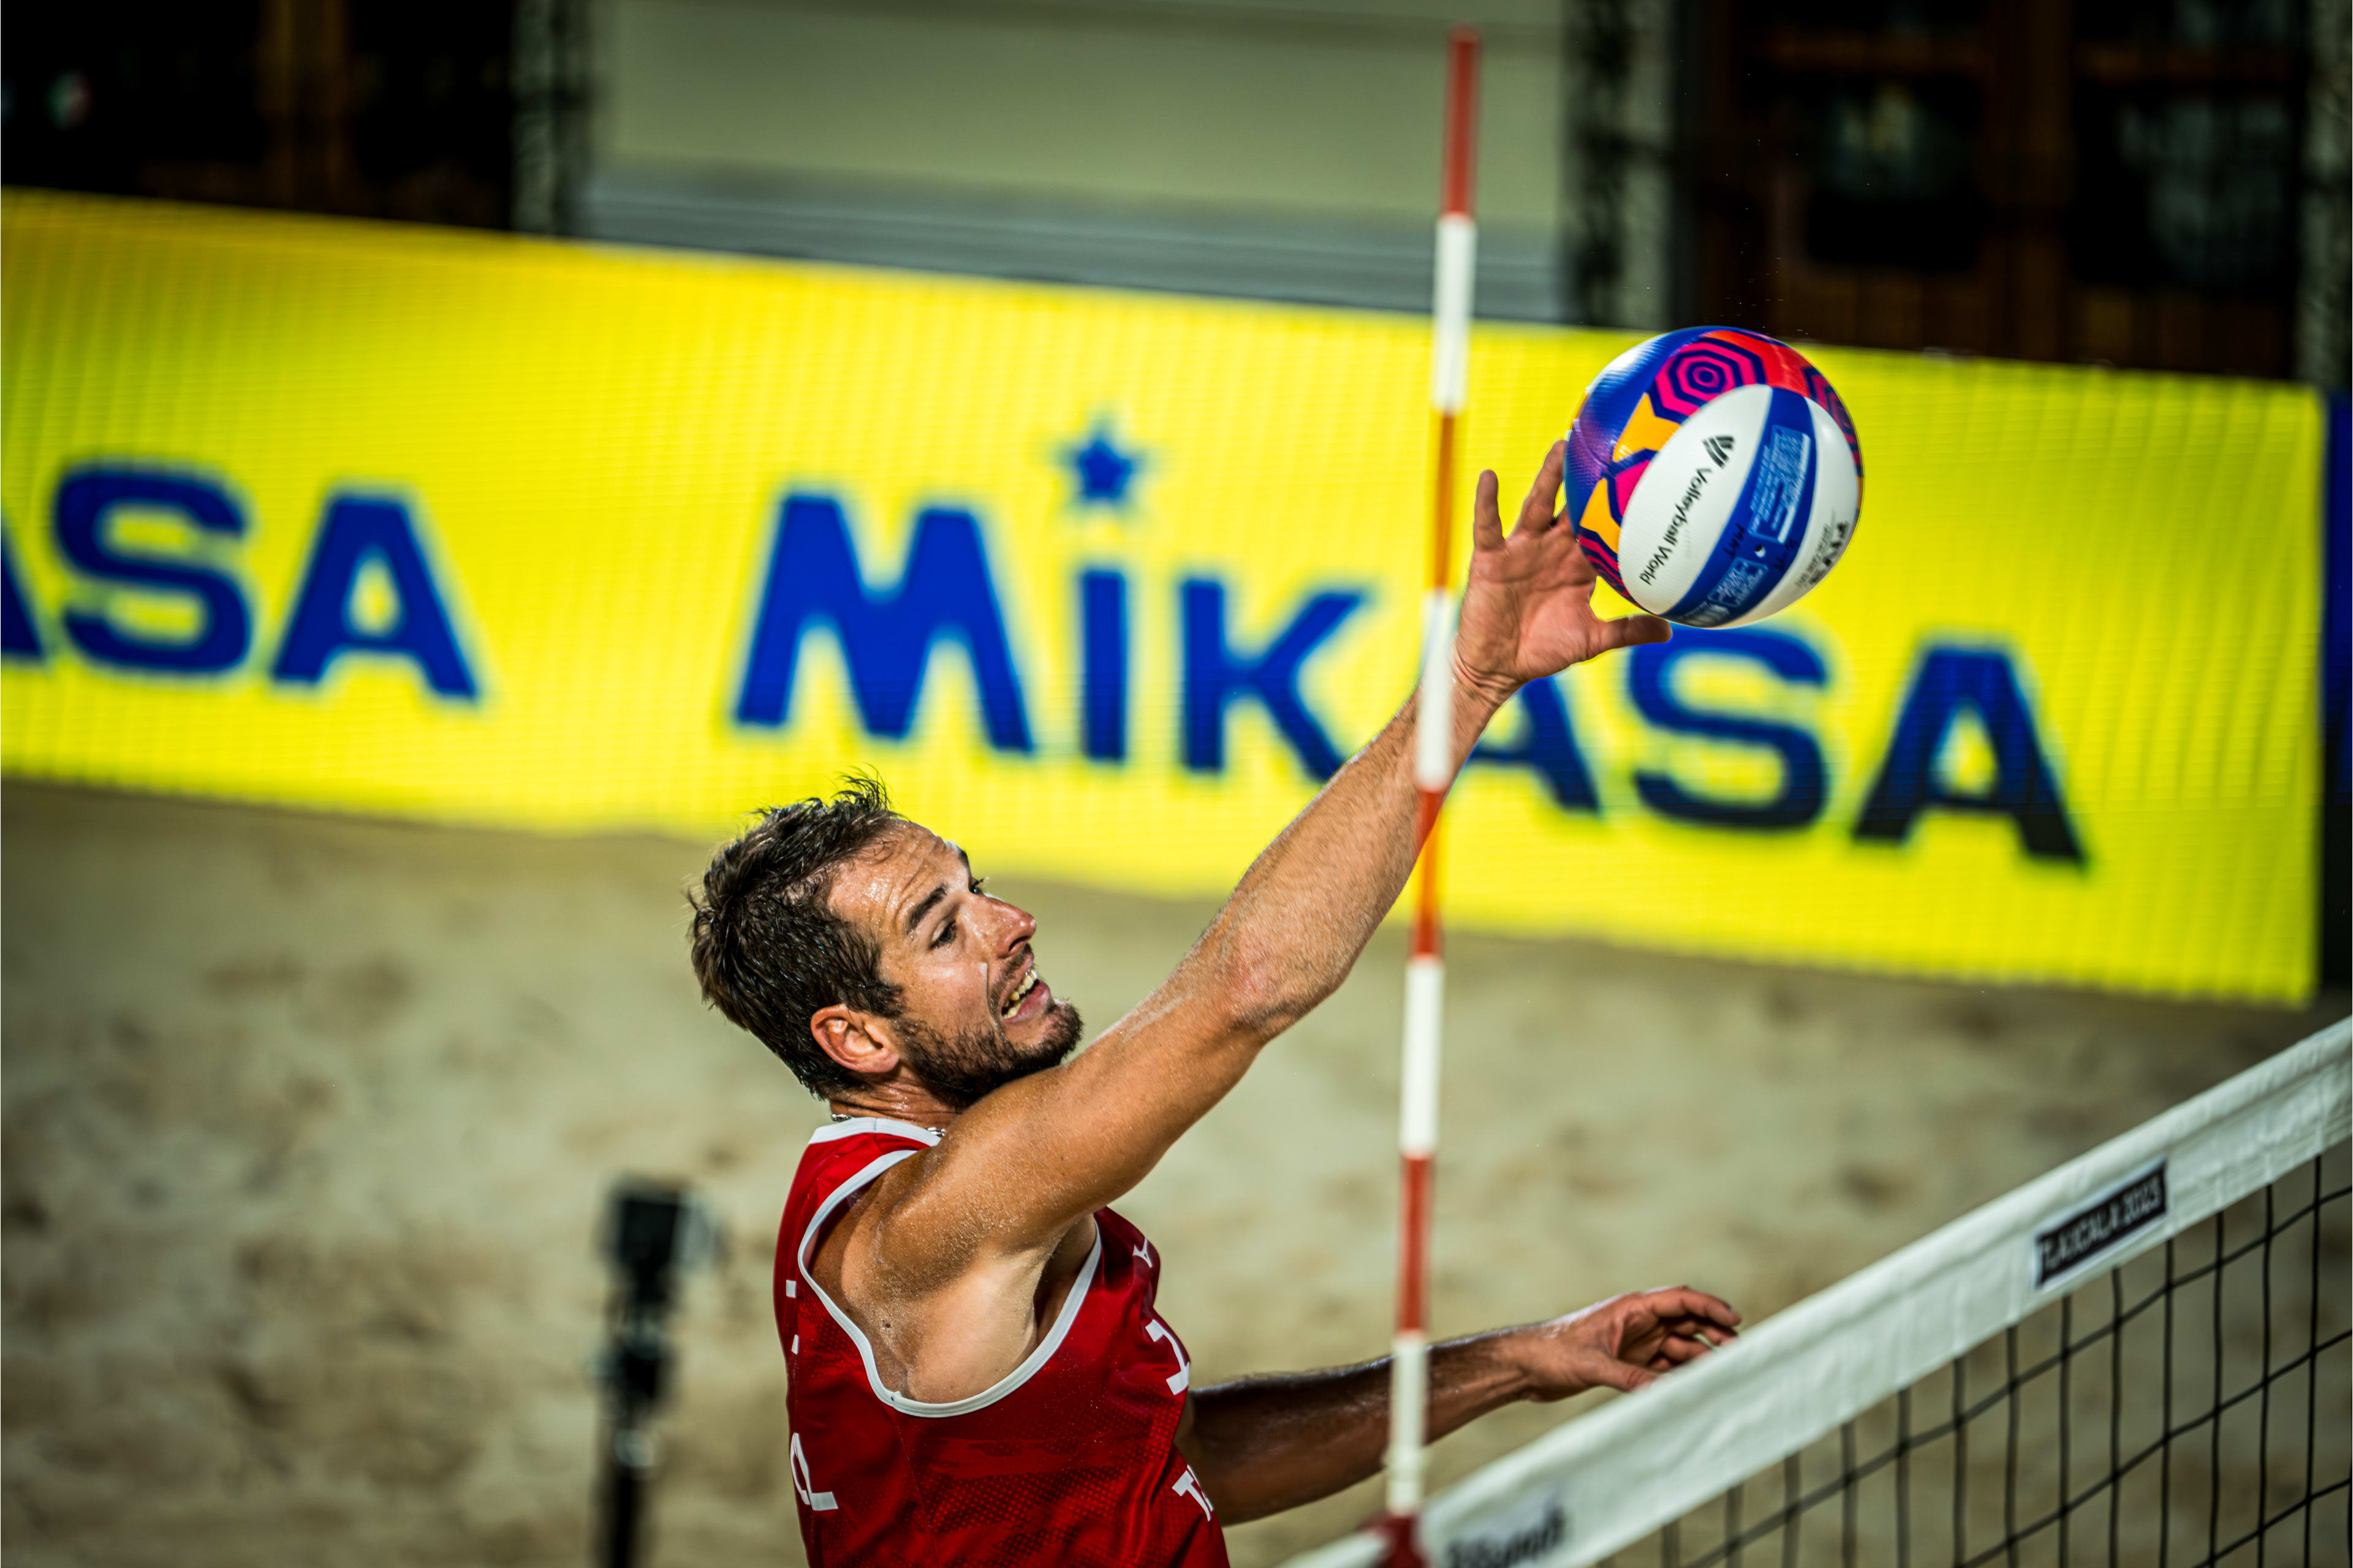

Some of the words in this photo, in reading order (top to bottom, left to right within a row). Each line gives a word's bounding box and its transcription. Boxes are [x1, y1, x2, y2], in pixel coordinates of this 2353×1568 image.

[1662, 467, 1713, 547] Volleyball
[0, 464, 482, 702] SA
[1639, 545, 1673, 586] World
